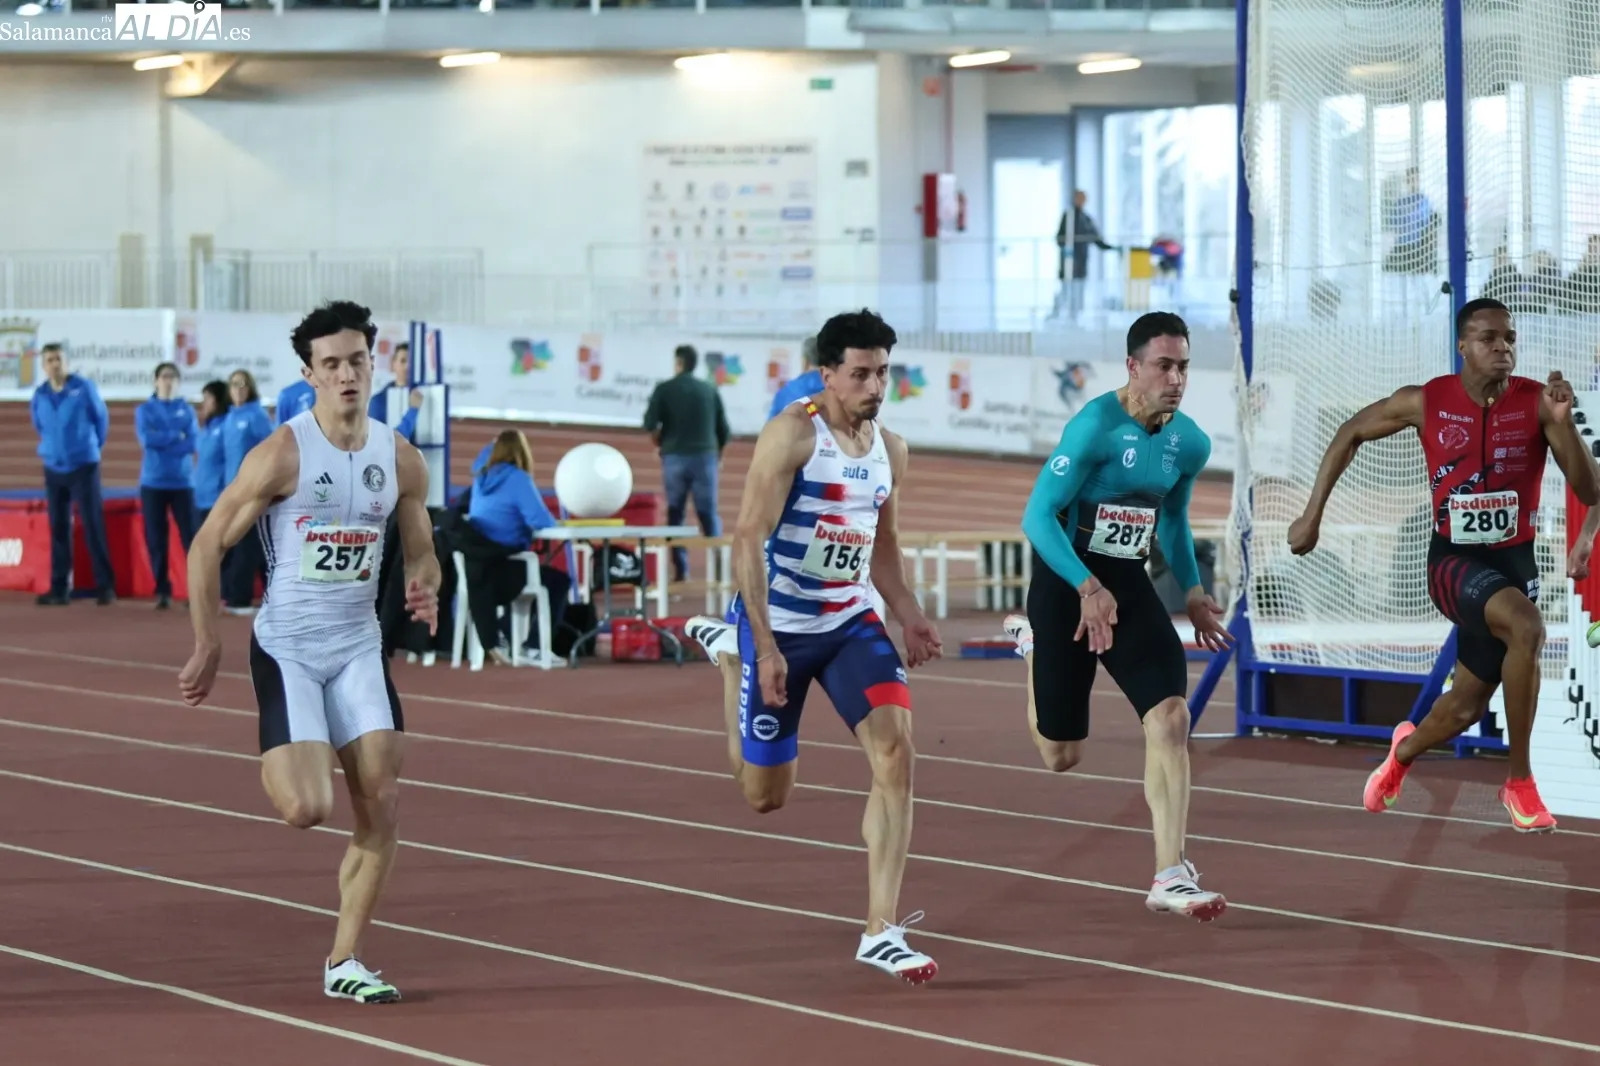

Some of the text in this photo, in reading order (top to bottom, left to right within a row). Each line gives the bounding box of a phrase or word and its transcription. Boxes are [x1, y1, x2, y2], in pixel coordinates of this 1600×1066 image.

[842, 465, 869, 480] aula
[1450, 494, 1517, 510] bedunia
[1098, 507, 1153, 525] bedunia
[1462, 509, 1509, 533] 280
[305, 529, 378, 545] bedunia
[815, 524, 872, 546] bedunia
[1104, 522, 1146, 547] 287
[315, 544, 367, 571] 257
[823, 543, 862, 571] 156
